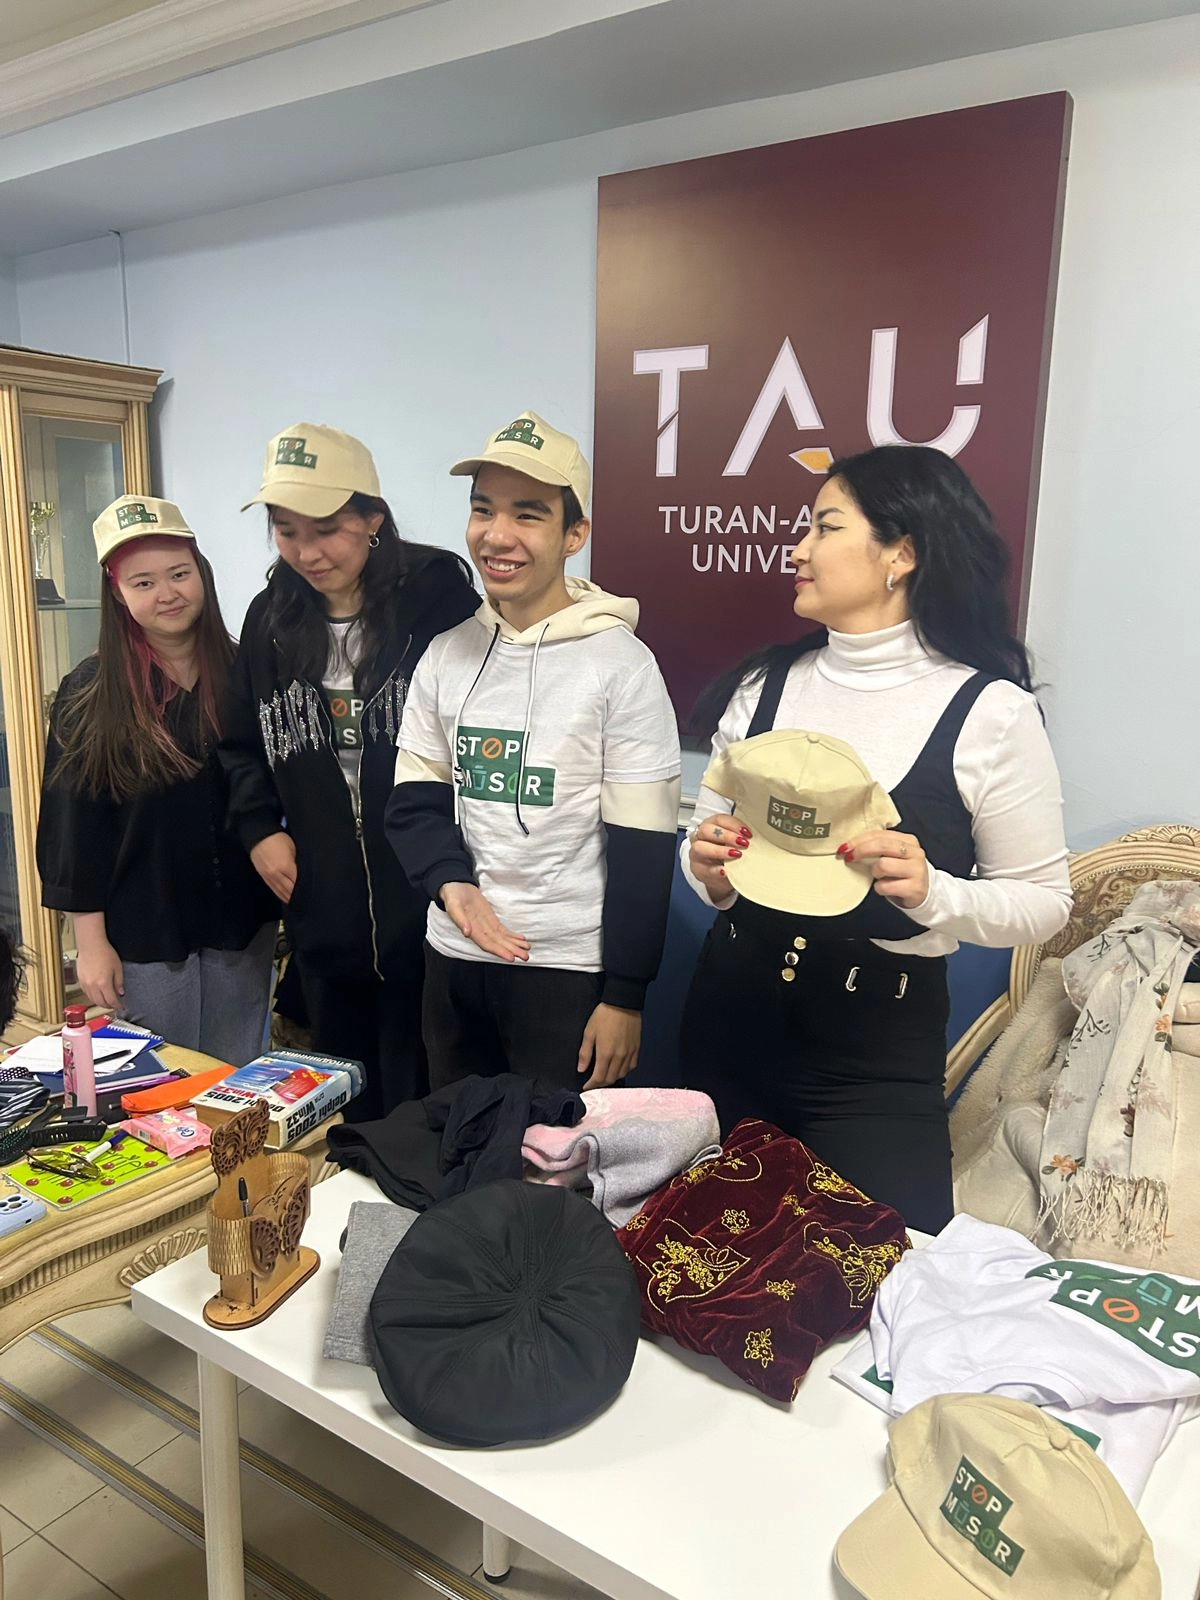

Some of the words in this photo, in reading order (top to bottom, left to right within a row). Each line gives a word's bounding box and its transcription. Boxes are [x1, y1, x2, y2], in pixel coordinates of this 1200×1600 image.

[633, 313, 989, 477] TAU
[203, 1090, 245, 1104] 2005
[243, 1098, 286, 1113] Dehi
[286, 1101, 316, 1130] Win32
[287, 1112, 317, 1144] 2005
